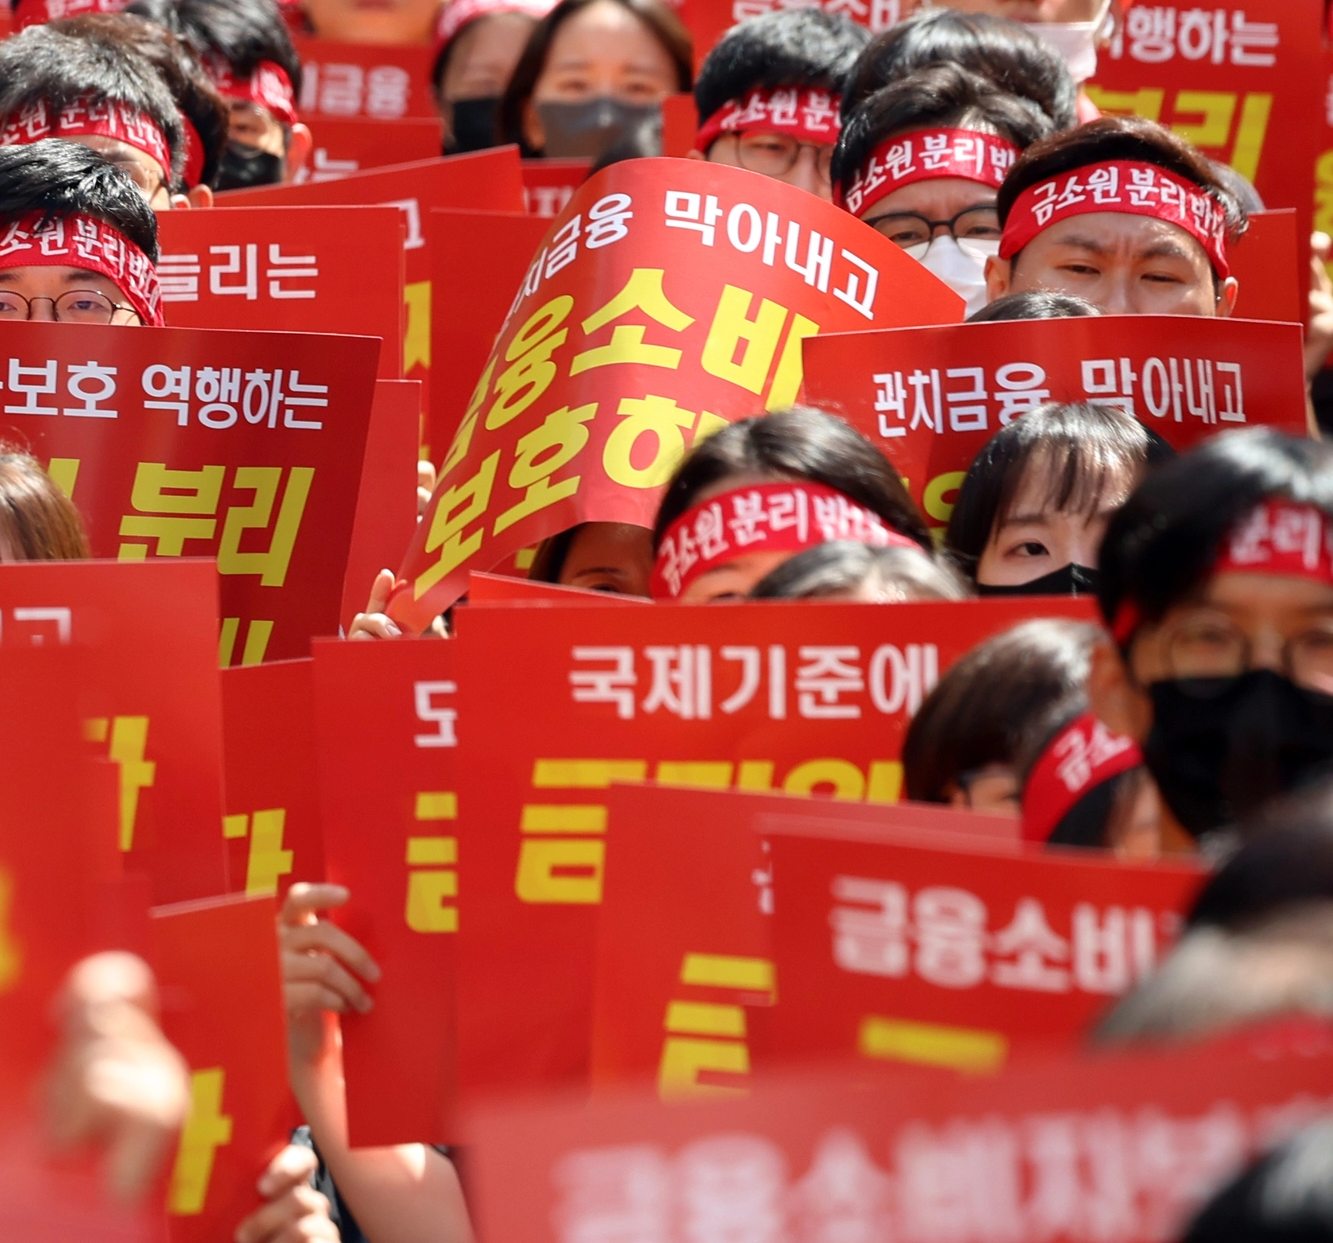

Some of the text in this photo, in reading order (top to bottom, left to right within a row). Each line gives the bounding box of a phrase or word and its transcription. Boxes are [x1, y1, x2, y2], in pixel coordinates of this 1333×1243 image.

[1029, 169, 1121, 227] 금소원
[664, 189, 881, 321] 막아내고
[141, 362, 330, 431] 역행하는
[873, 356, 1247, 439] 관치금융 막아내고
[117, 461, 315, 588] 분리
[569, 644, 940, 721] 국제기준에
